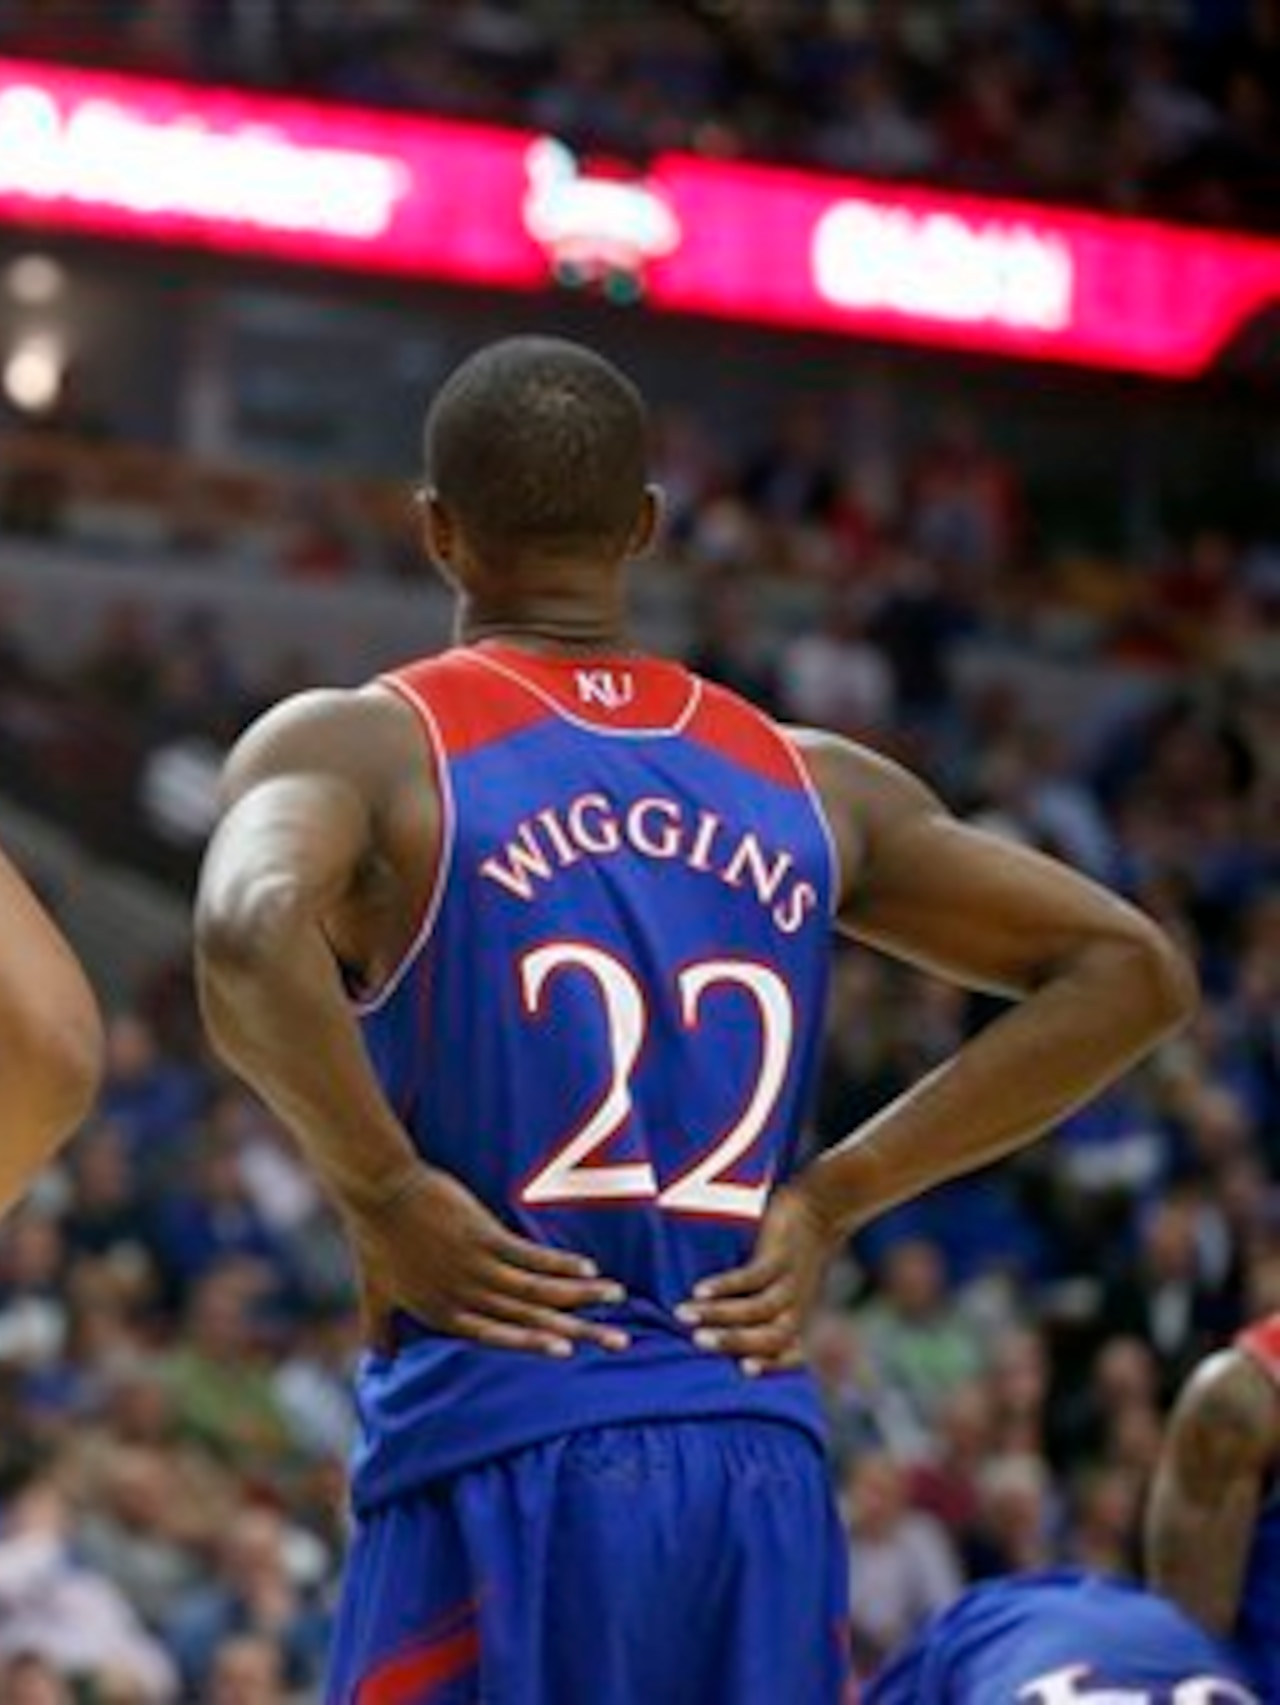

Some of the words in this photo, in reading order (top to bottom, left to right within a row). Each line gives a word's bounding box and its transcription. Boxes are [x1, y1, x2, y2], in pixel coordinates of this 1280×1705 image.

[575, 669, 634, 710] KU
[478, 793, 817, 934] WIGGINS
[519, 940, 795, 1220] 22
